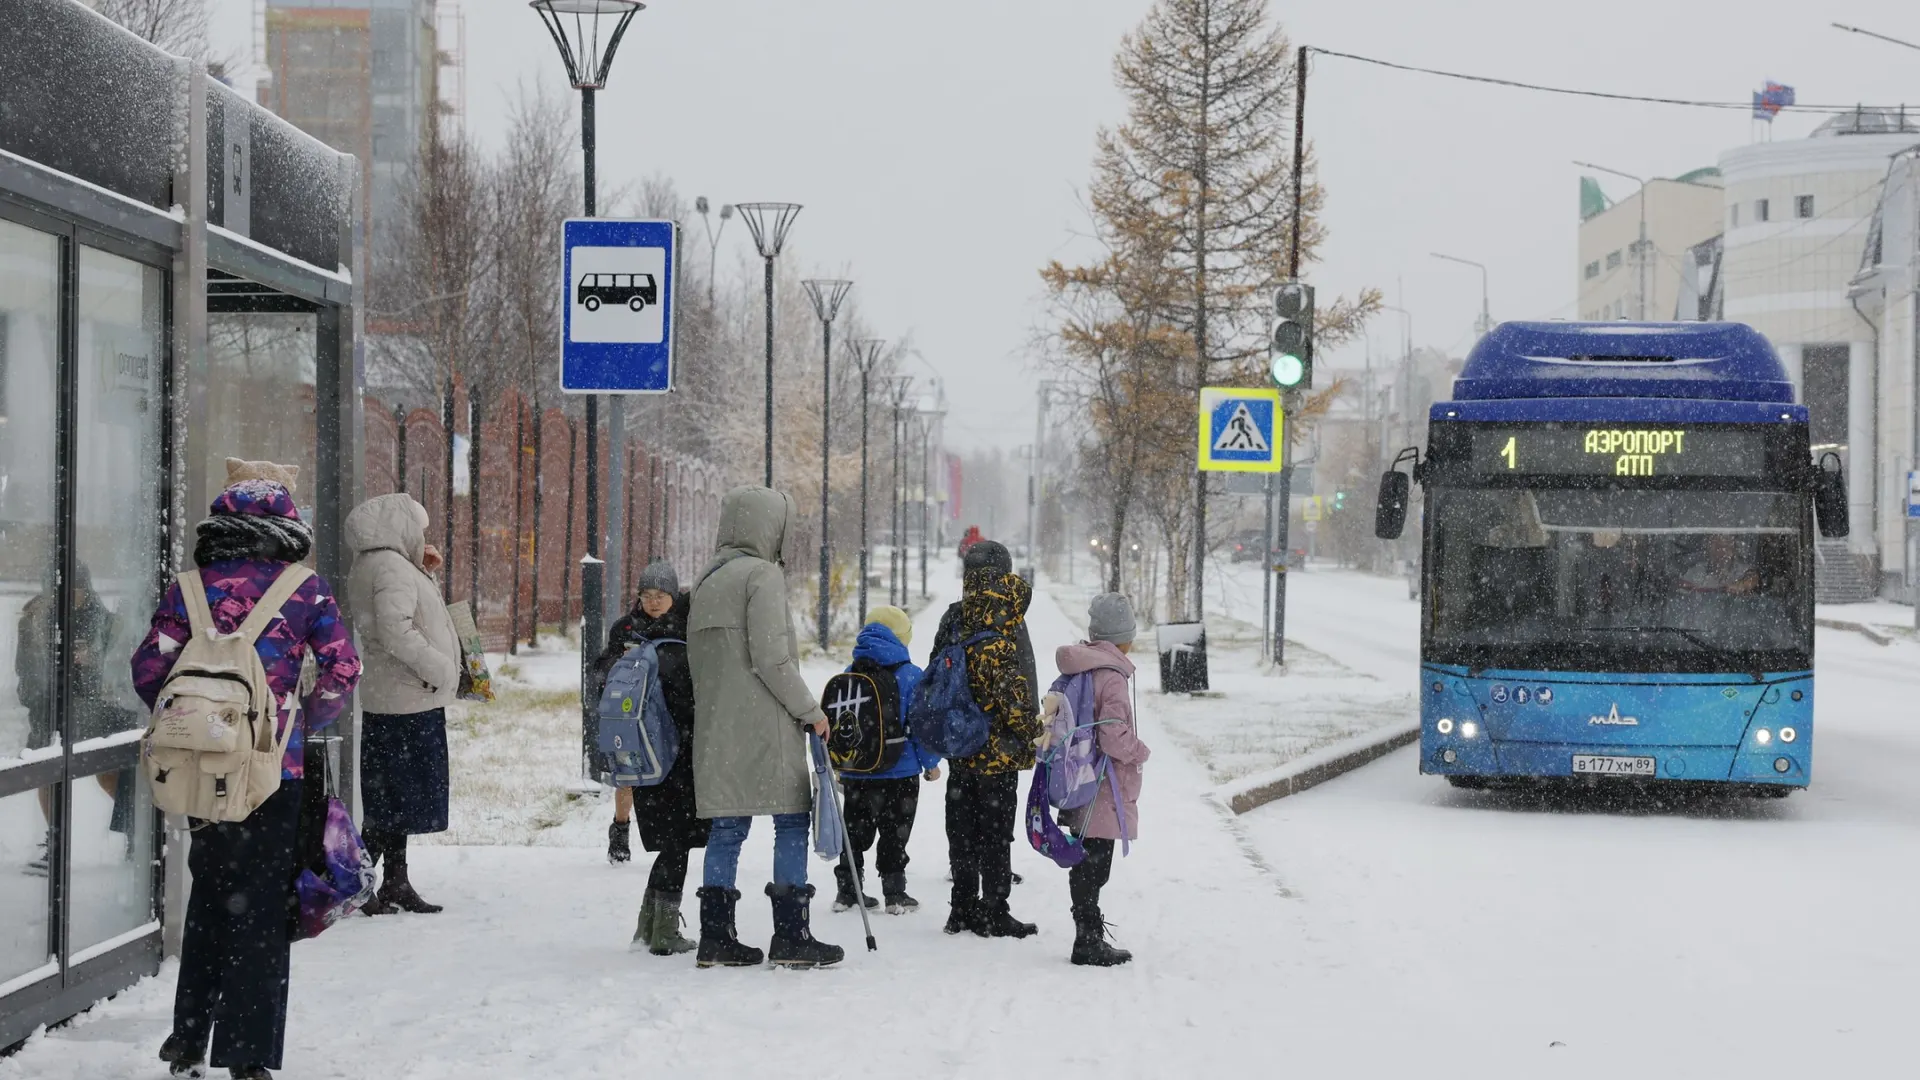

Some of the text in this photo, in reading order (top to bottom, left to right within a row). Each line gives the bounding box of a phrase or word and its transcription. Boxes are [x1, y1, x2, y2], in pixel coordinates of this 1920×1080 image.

[1500, 436, 1516, 469] 1
[1585, 430, 1685, 453] АЭРОПОРТ
[1616, 455, 1653, 476] АТП
